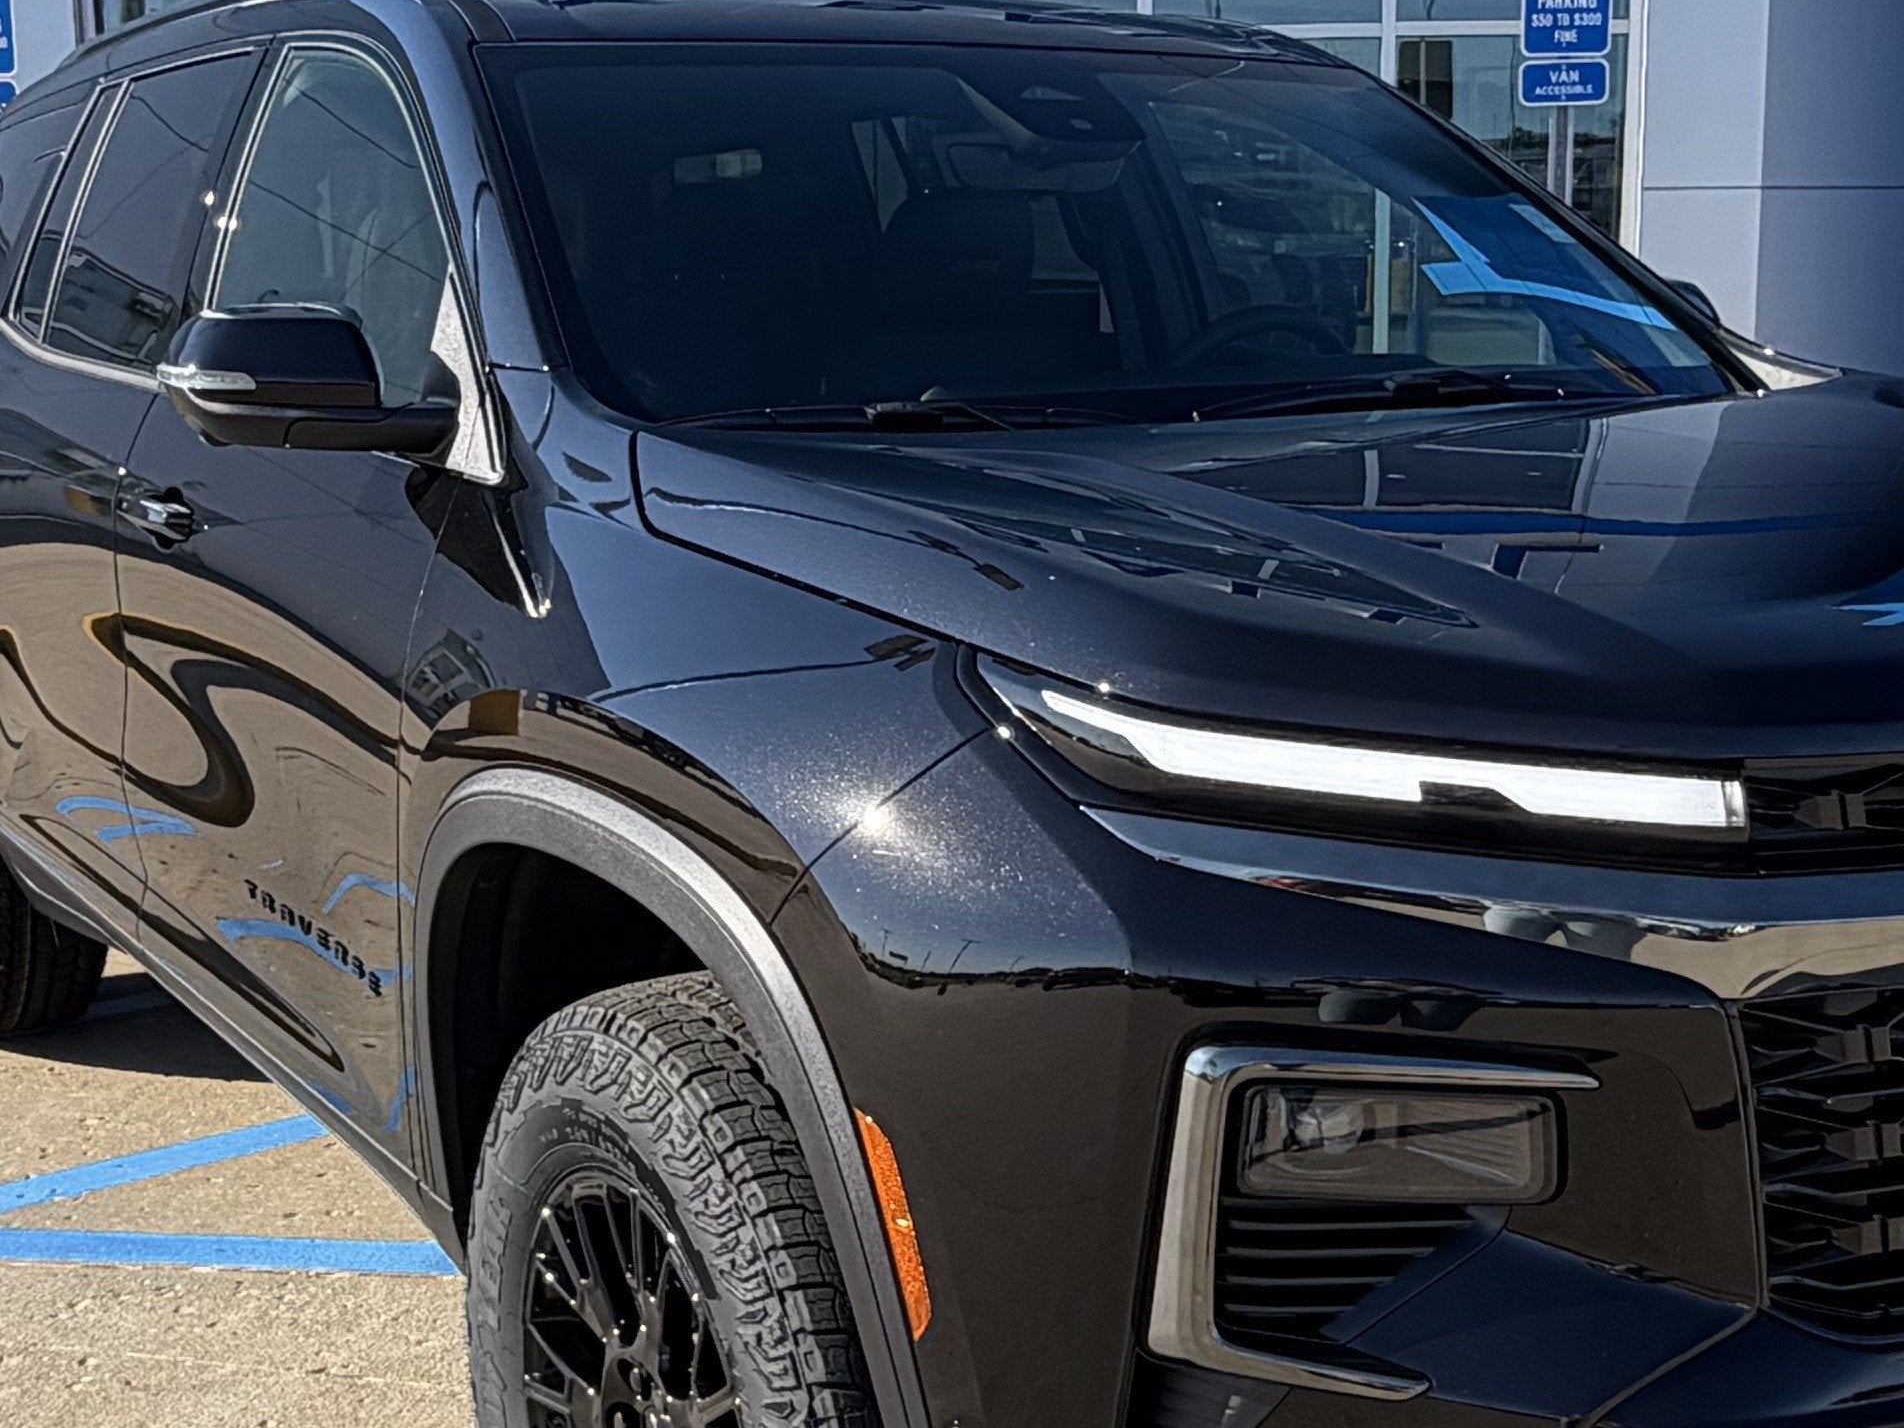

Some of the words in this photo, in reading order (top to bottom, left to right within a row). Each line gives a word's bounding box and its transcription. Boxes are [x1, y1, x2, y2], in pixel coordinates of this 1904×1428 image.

[1531, 13, 1553, 27] $50
[1557, 13, 1570, 26] TO
[1574, 12, 1602, 26] $300
[1554, 29, 1578, 43] FINE
[1549, 70, 1580, 84] VAN
[1535, 84, 1594, 95] ACCESSIBLE
[245, 878, 382, 997] TRAVERSE
